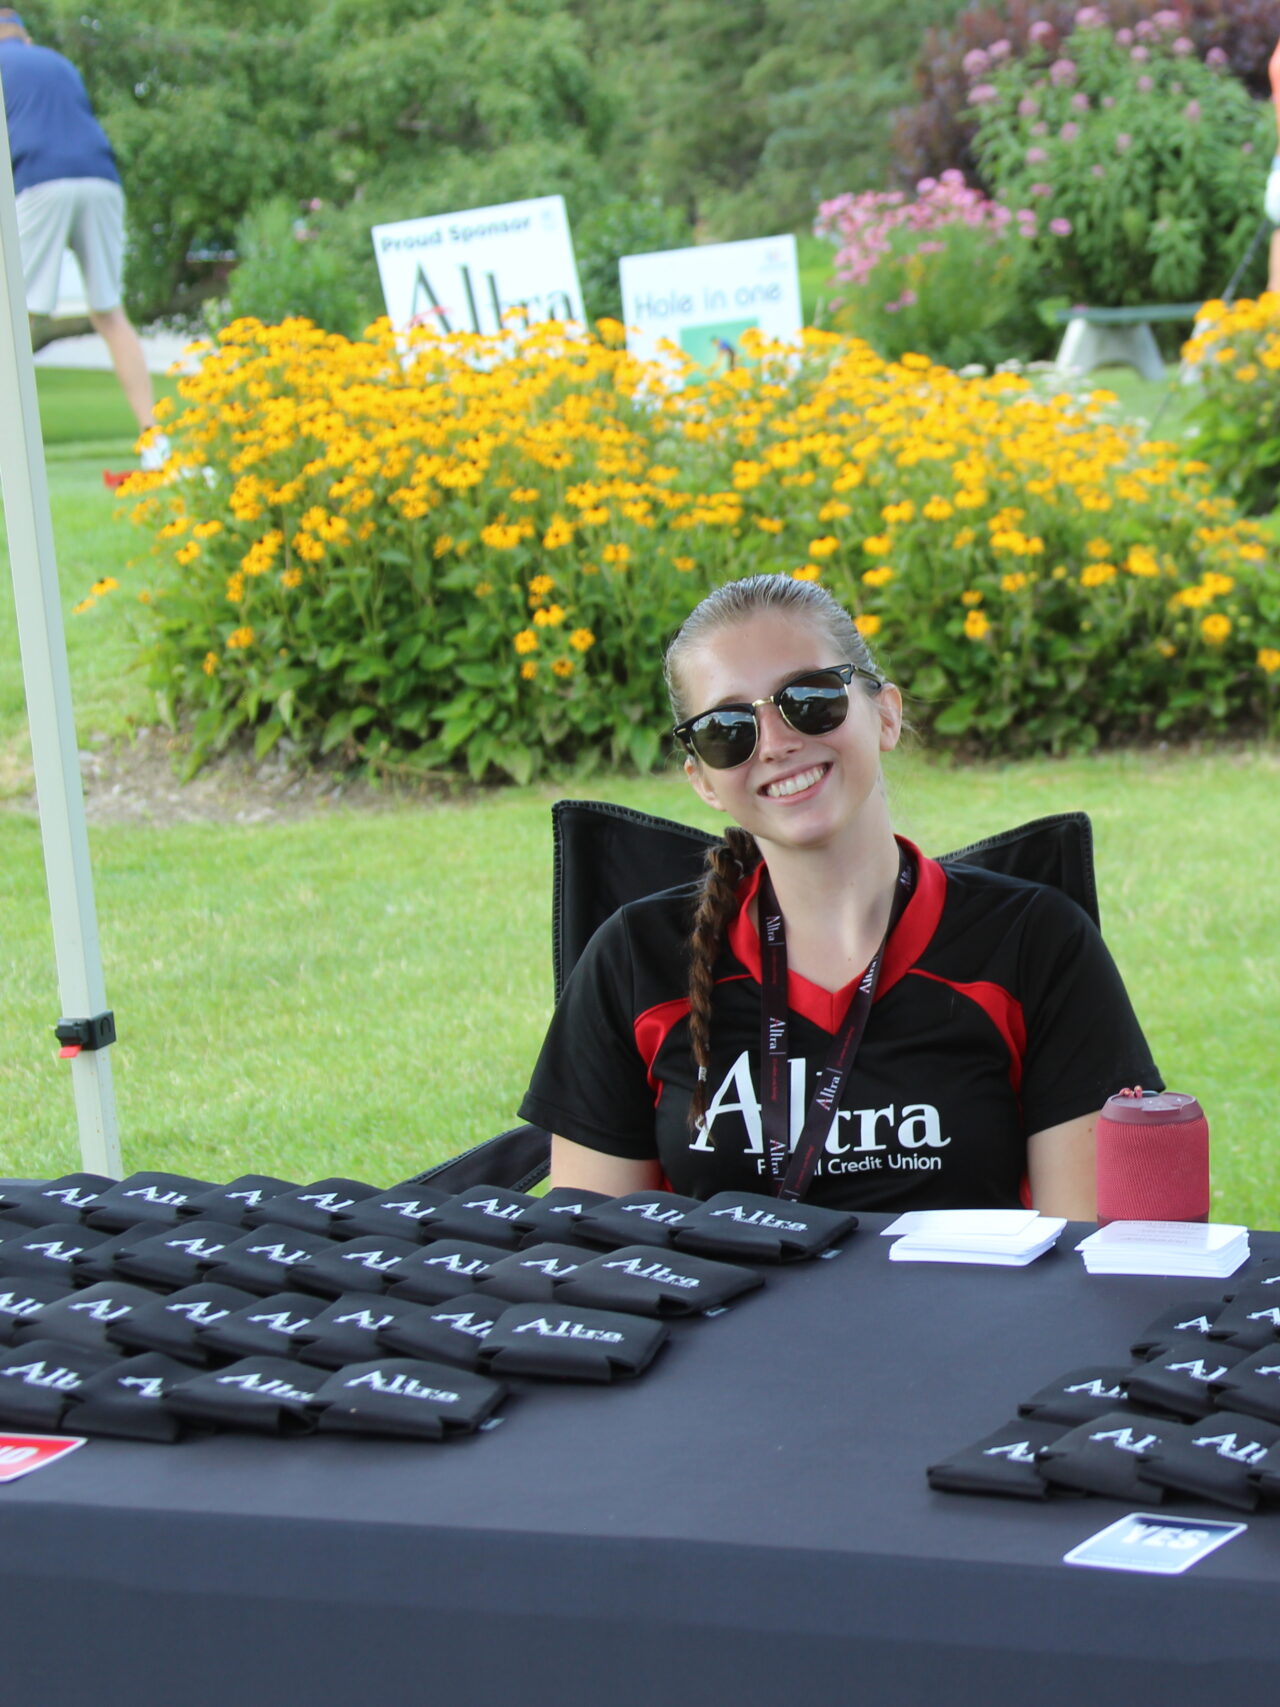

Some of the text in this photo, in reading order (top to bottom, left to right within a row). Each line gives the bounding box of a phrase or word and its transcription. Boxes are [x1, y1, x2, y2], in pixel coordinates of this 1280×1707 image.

[381, 216, 530, 252] Proud Sponsor
[635, 281, 782, 319] Hole in one
[769, 1017, 786, 1050] Altra
[815, 1076, 840, 1111] Altra
[770, 1139, 786, 1175] Altra
[828, 1157, 882, 1175] Credit
[888, 1153, 942, 1170] Union
[709, 1206, 807, 1231] Altra
[602, 1257, 699, 1288] Altra
[512, 1317, 625, 1343] Altra
[344, 1370, 460, 1403] Altra
[1121, 1524, 1210, 1549] YES
